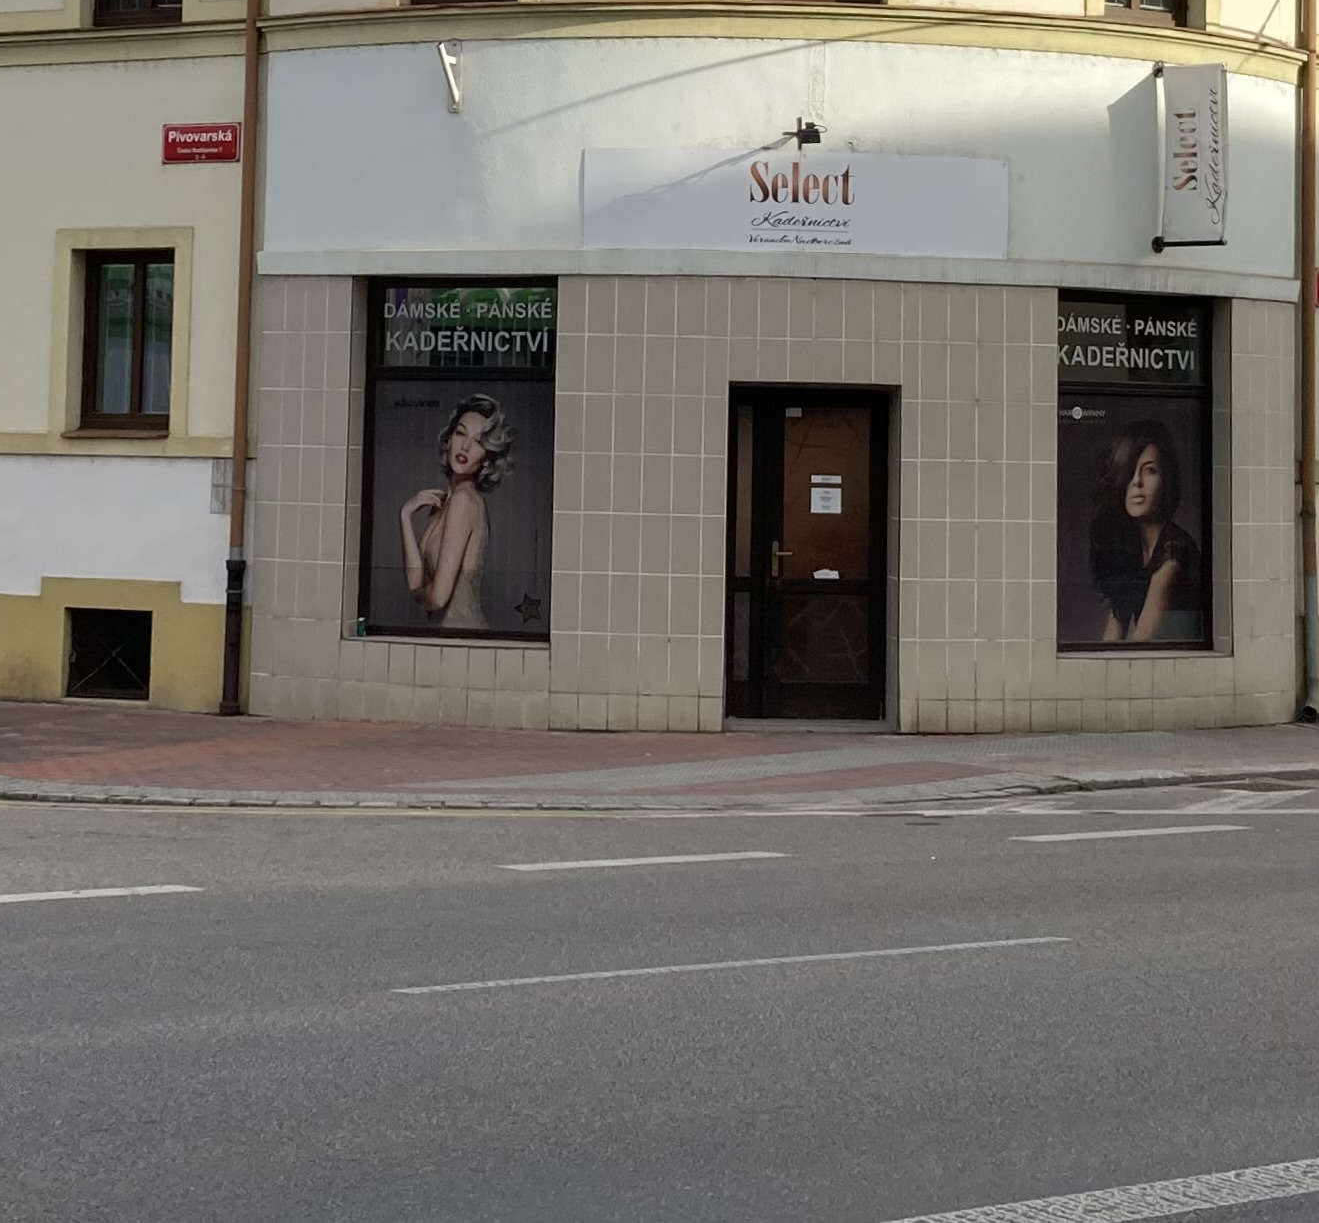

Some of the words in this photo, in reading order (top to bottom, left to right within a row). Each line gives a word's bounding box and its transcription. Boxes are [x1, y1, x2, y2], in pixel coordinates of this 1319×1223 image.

[168, 129, 232, 143] Pivovarská
[1172, 108, 1198, 191] Select
[749, 160, 856, 206] Select
[383, 298, 461, 319] DÁMSKÉ
[476, 298, 553, 319] PÁNSKÉ
[1057, 313, 1122, 335] DÁMSKÉ
[1134, 316, 1198, 338] PÁNSKÉ
[385, 326, 549, 353] KADEŘNICTVÍ
